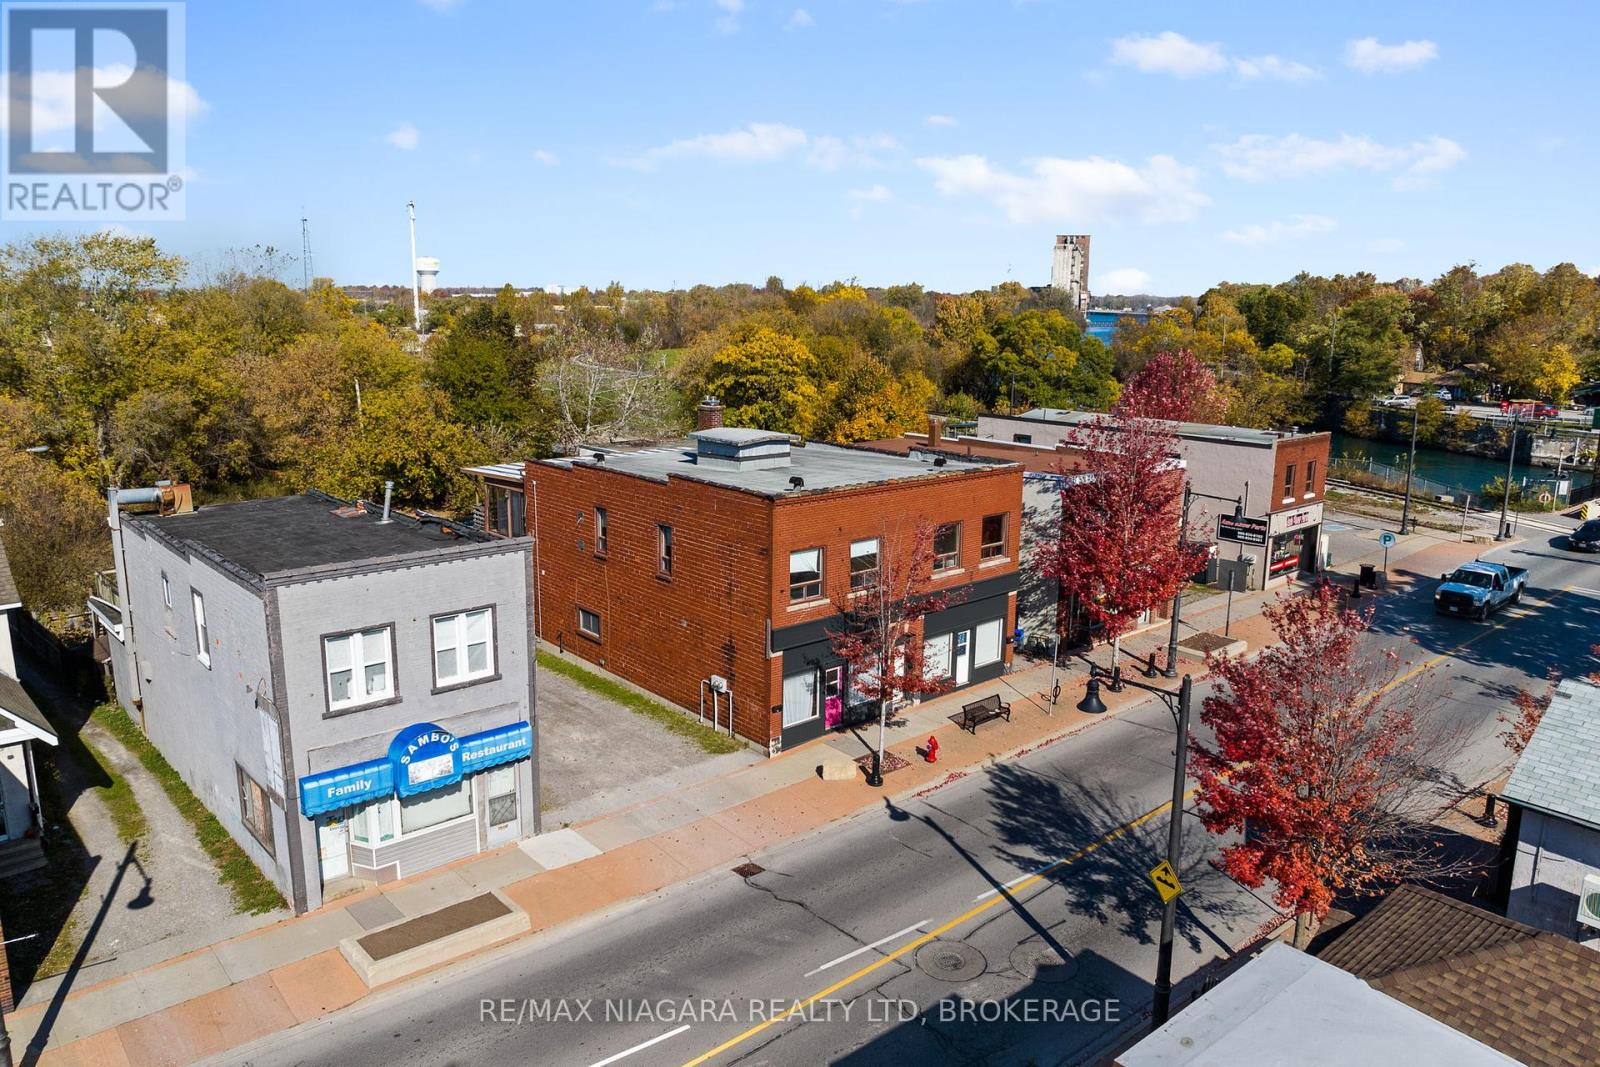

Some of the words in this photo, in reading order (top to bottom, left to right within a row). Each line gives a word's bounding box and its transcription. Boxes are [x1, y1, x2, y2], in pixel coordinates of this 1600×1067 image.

[401, 732, 459, 765] SAMBO'S
[462, 737, 527, 762] Restaurant
[327, 779, 372, 798] Family
